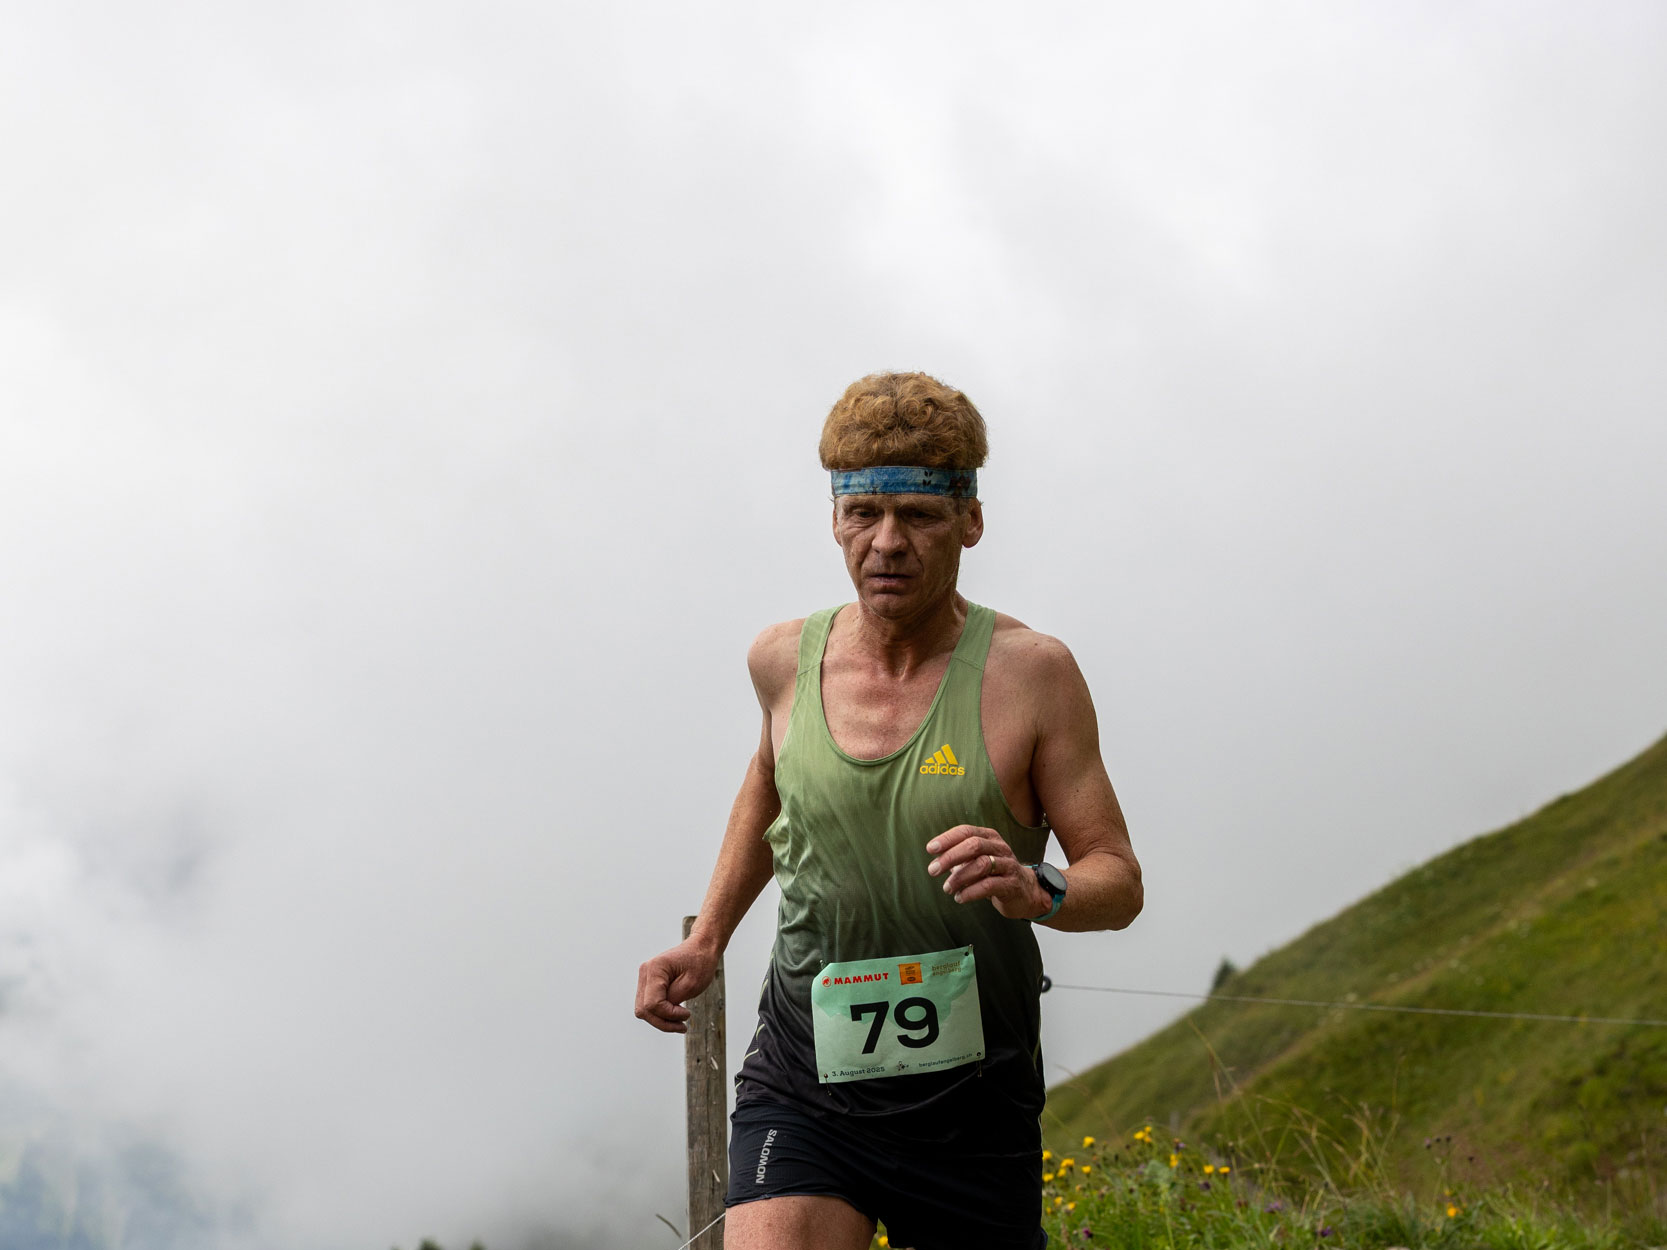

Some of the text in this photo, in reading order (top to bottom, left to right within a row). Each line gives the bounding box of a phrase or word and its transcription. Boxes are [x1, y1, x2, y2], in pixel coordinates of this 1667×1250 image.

[919, 763, 965, 775] adidas
[834, 973, 889, 985] MAMMUT
[850, 997, 940, 1054] 79
[839, 1068, 866, 1077] August
[866, 1066, 885, 1074] 2025
[756, 1129, 777, 1184] SALOMON
